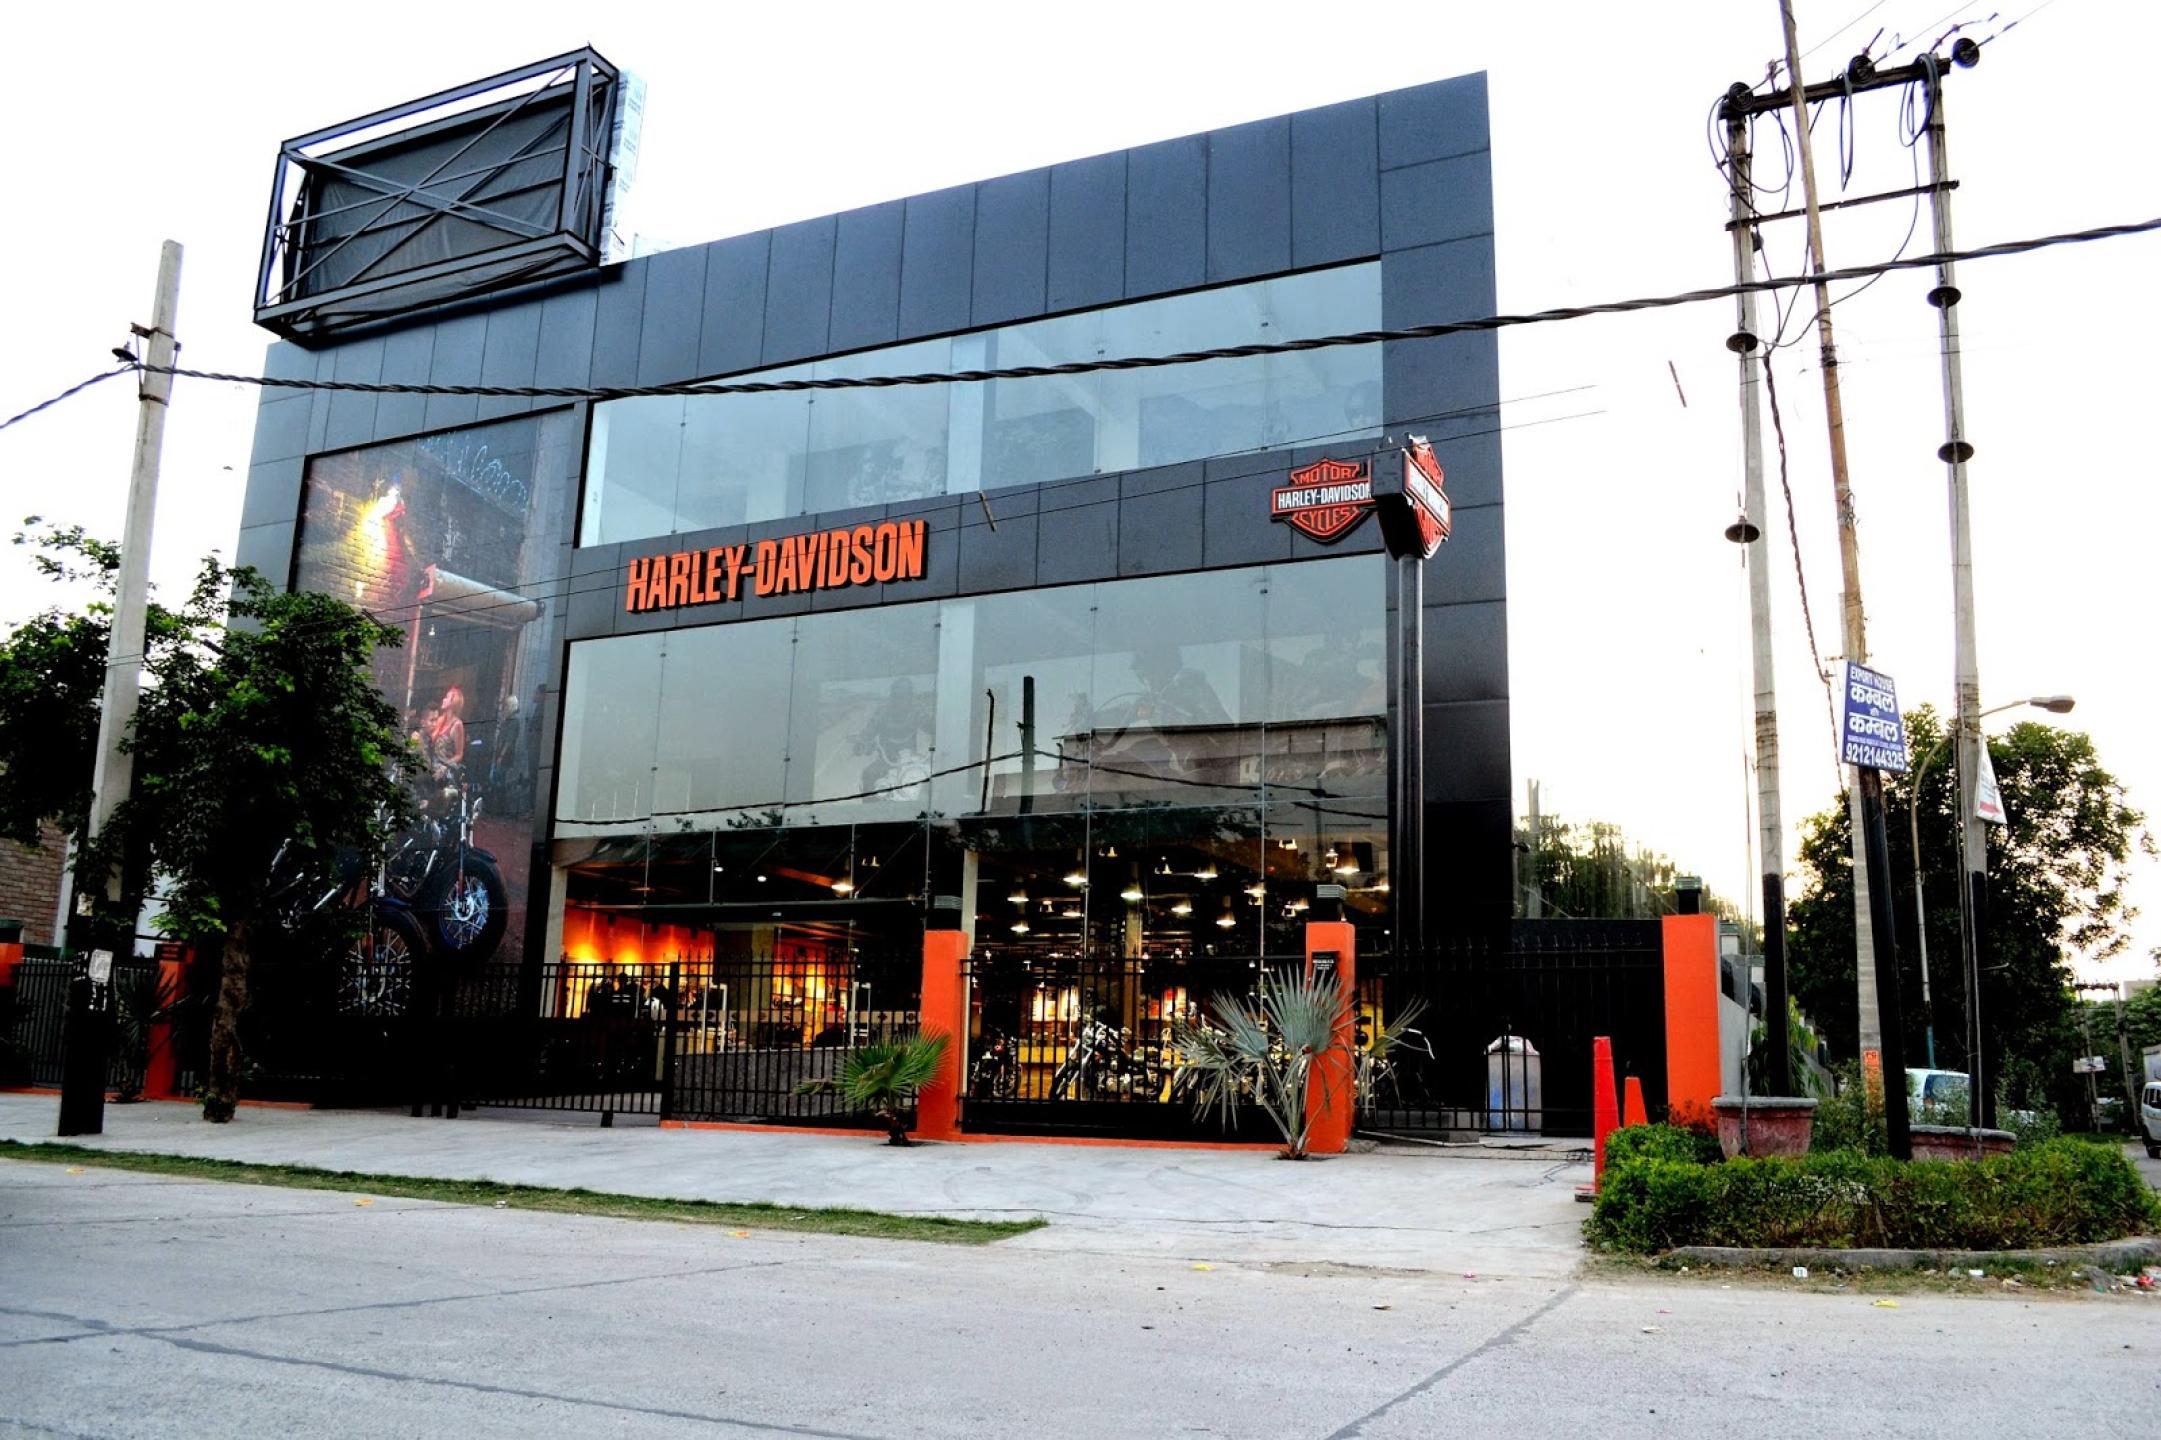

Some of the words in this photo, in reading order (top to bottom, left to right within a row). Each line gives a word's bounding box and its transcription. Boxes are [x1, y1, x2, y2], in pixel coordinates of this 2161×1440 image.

[1299, 464, 1353, 483] MOTOR
[1299, 507, 1350, 531] CYCLES
[625, 519, 926, 612] HARLEY-DAVIDSON
[1851, 666, 1873, 685] EXPORT
[1850, 682, 1895, 713] कम्बल
[1849, 712, 1899, 742] कम्बल
[1845, 742, 1904, 769] 9212144325
